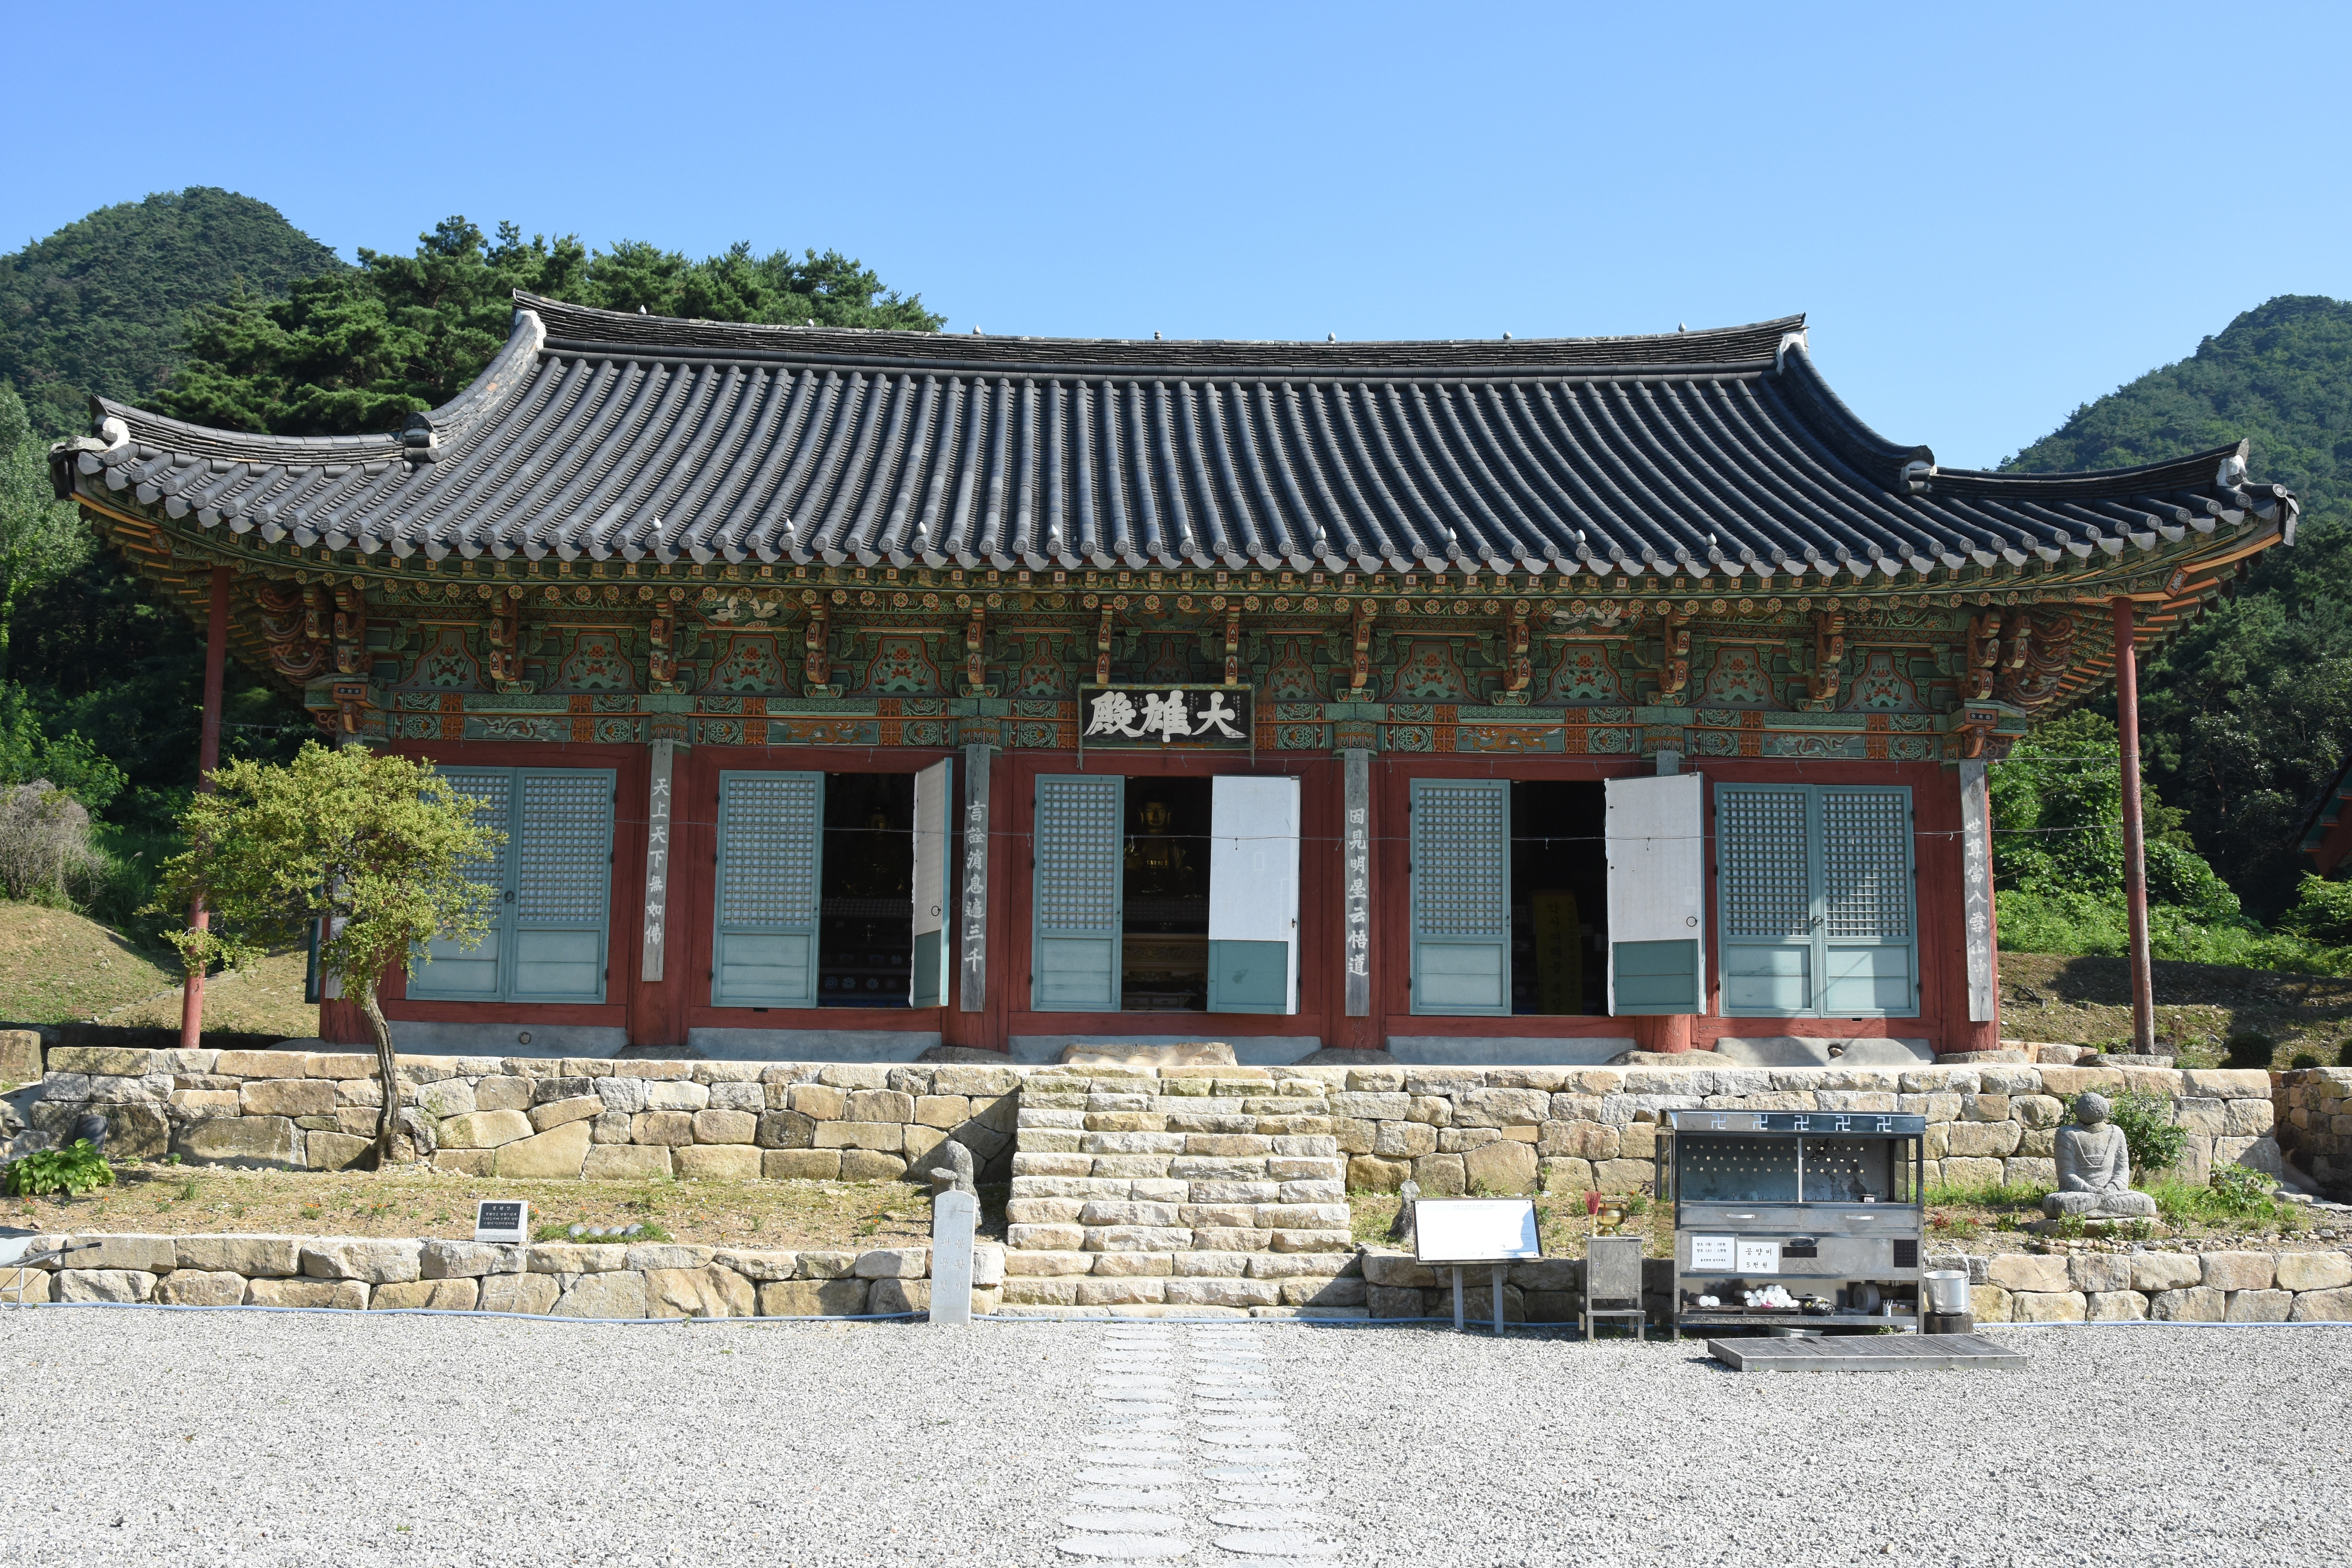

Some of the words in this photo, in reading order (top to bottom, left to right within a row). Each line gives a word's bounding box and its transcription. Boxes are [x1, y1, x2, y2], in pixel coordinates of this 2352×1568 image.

[1083, 690, 1248, 742] 大雄殿
[645, 778, 670, 945] 天上天下無如佛
[964, 800, 987, 972] 言詮消息遍三千
[1348, 807, 1368, 976] 因見明星云悟道
[1965, 818, 1988, 983] 世尊當入雪山中
[939, 1237, 950, 1292] 대웅전
[954, 1238, 965, 1292] 봉황사
[1745, 1248, 1772, 1256] 공양미
